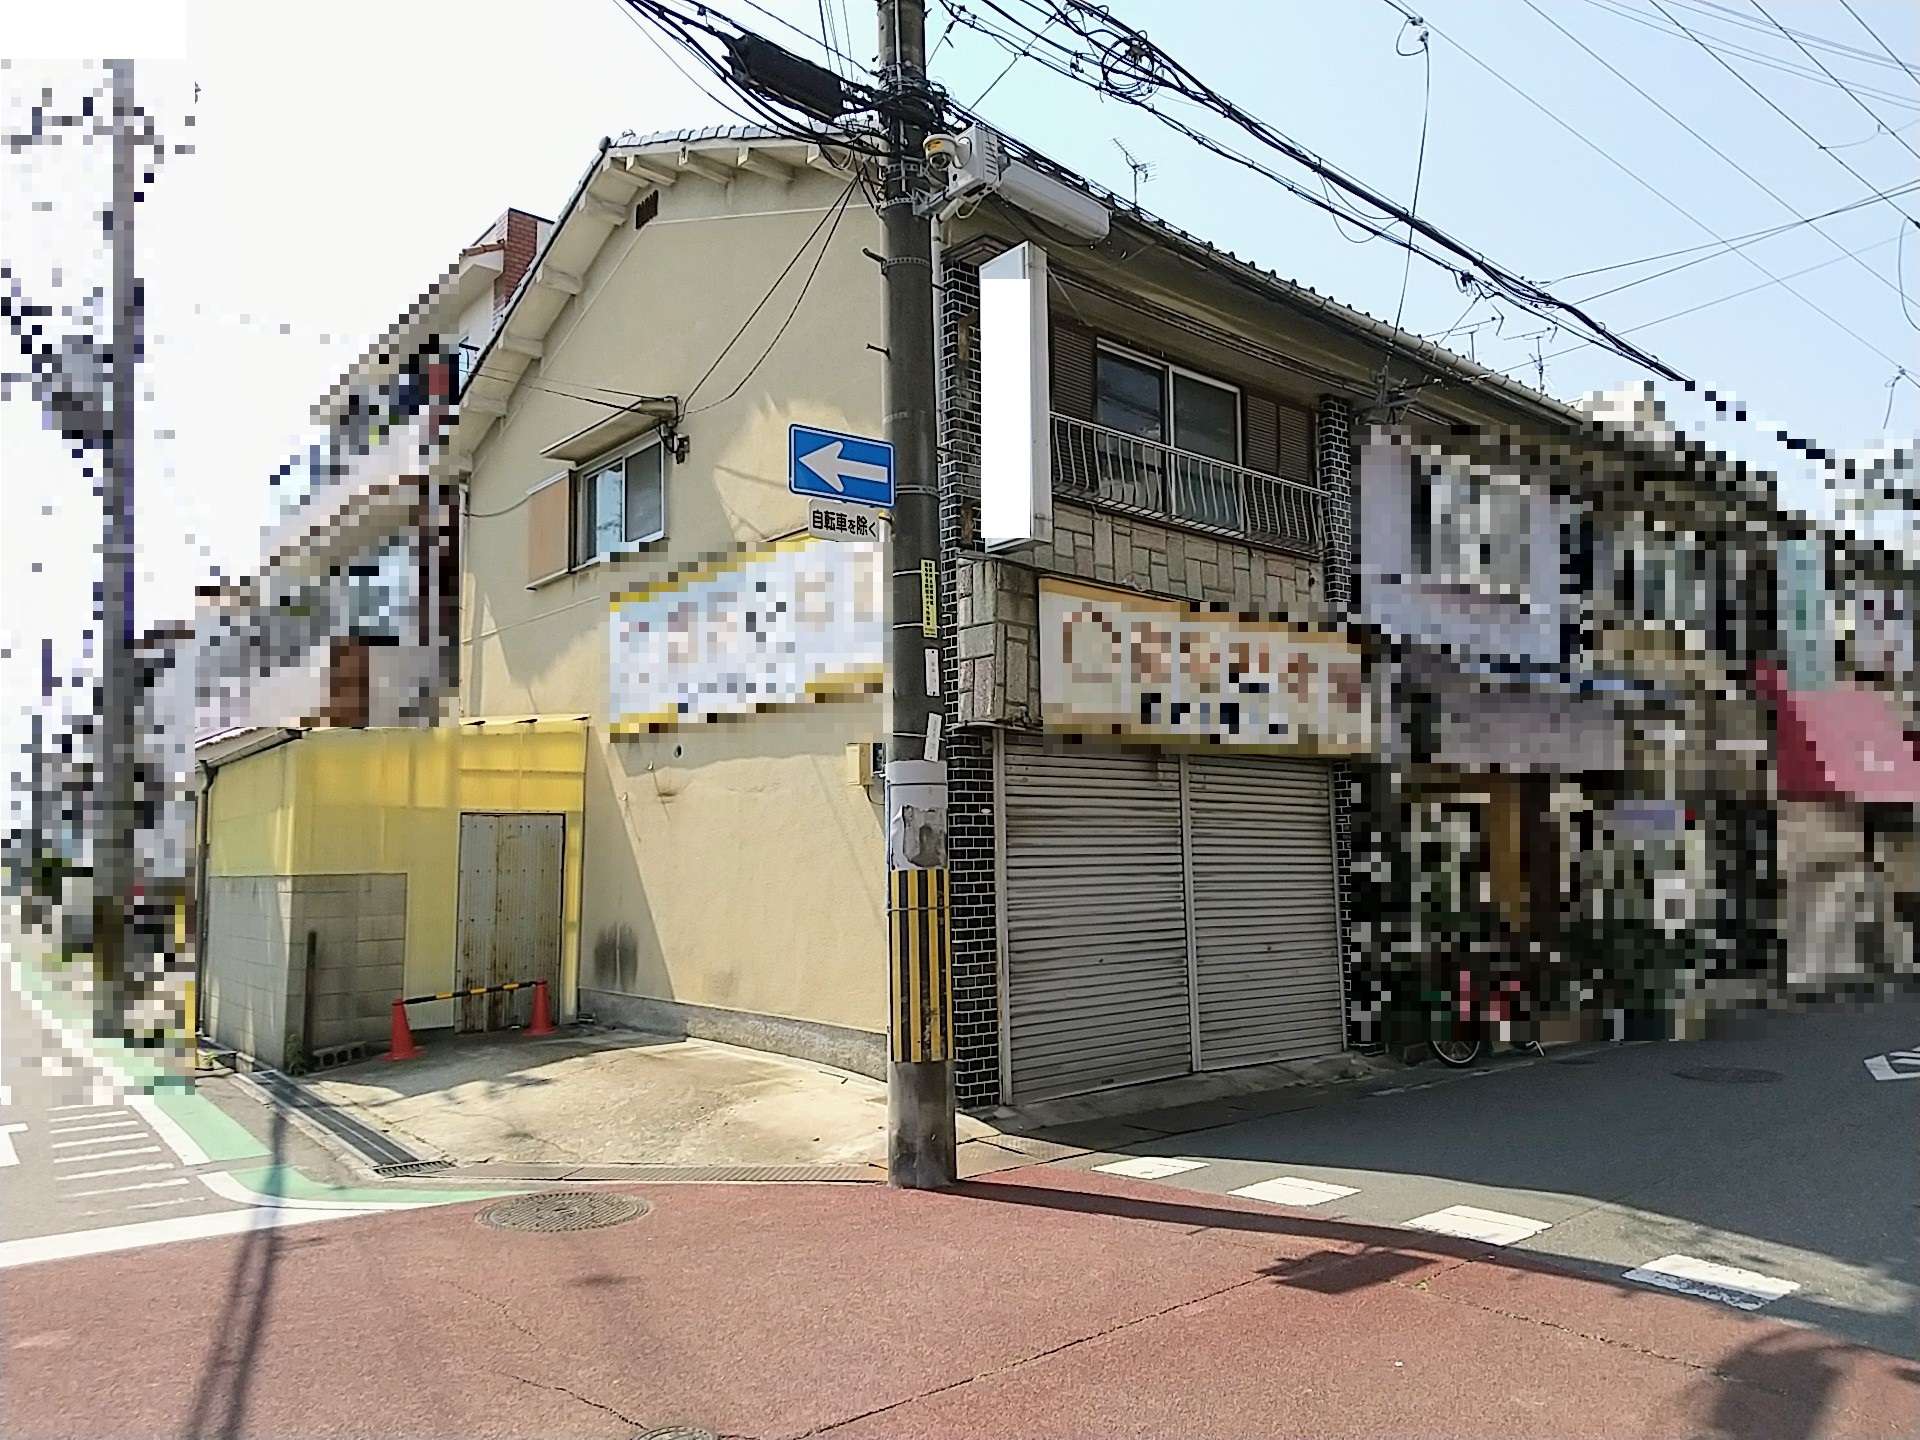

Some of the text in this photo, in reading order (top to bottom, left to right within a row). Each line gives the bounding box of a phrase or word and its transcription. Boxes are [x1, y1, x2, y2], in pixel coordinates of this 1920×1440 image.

[812, 509, 877, 537] 自転車を除く
